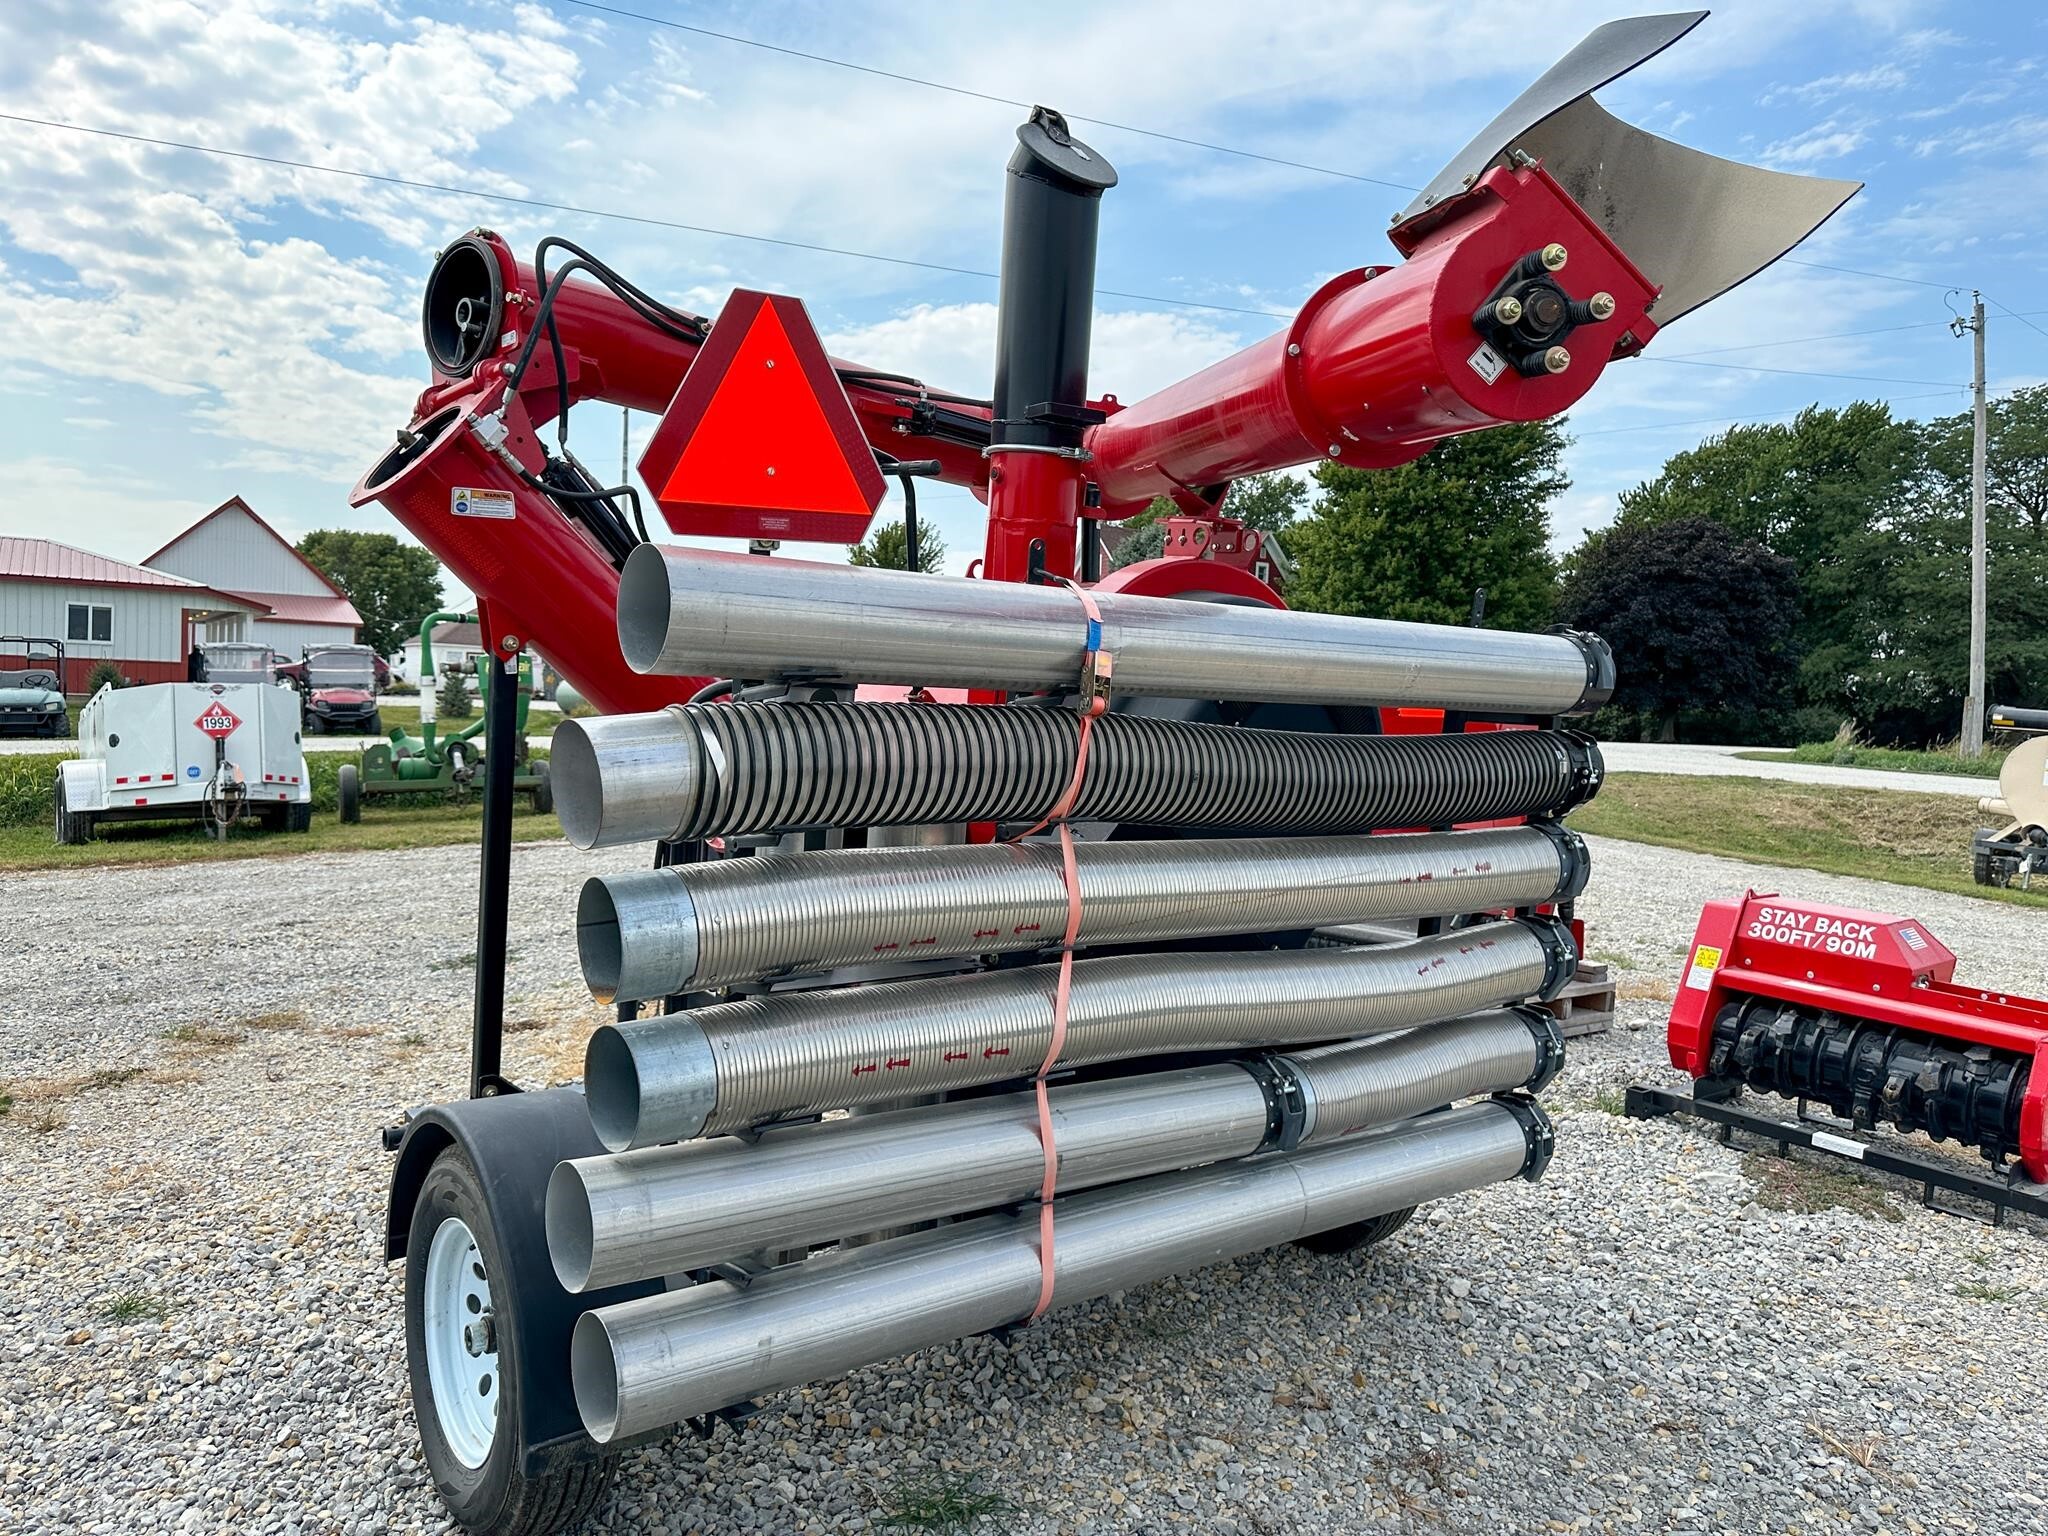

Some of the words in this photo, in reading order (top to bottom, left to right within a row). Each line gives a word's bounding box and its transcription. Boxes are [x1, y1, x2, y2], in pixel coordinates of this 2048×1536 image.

[204, 717, 232, 729] 1993
[1747, 922, 1877, 960] 300FT/90M
[1758, 907, 1811, 929] STAY
[1814, 916, 1877, 942] BACK
